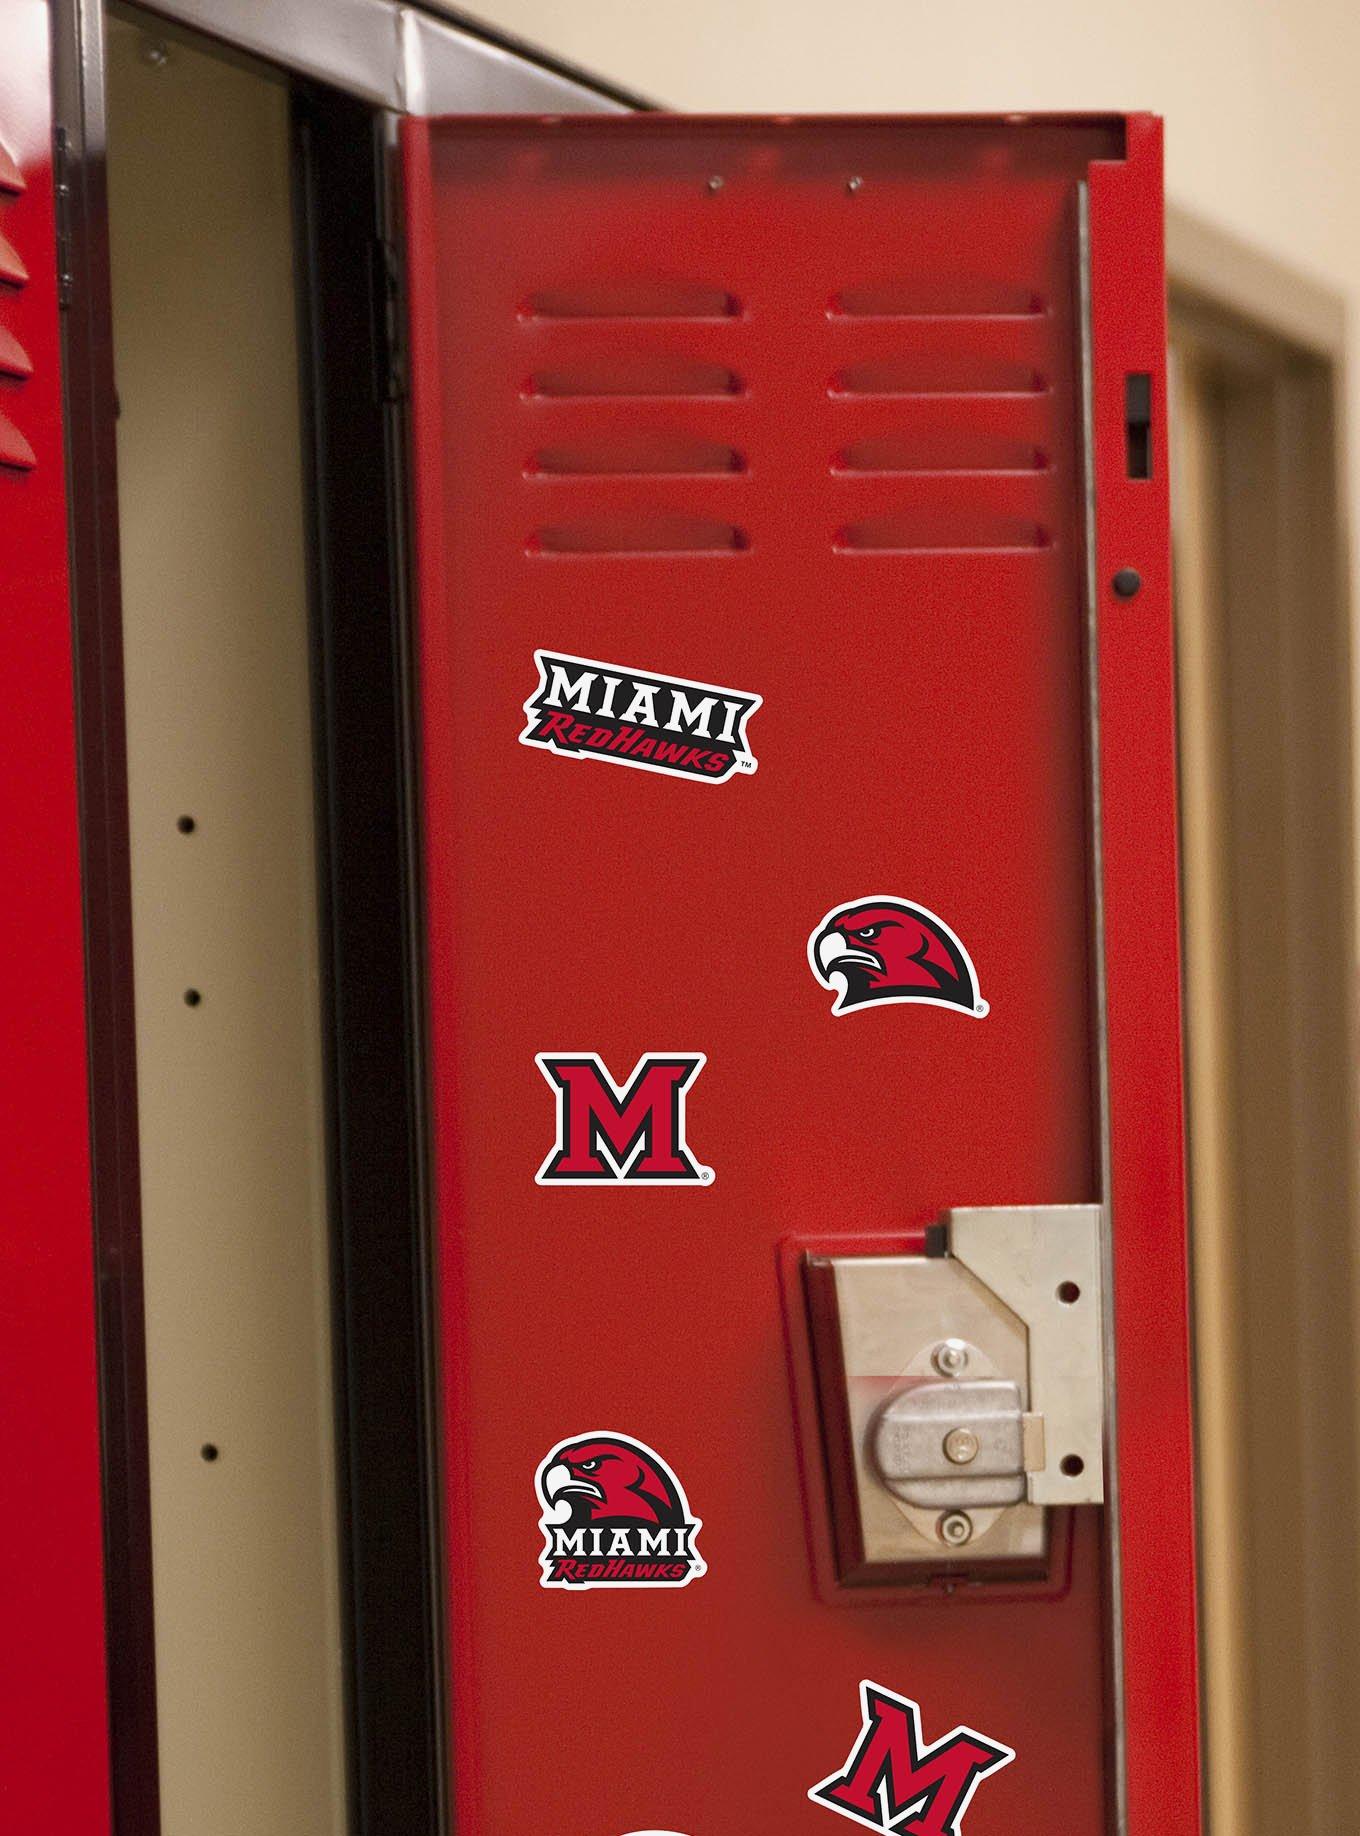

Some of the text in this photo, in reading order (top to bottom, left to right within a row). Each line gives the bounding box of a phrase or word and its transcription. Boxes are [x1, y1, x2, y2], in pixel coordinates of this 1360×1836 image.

[542, 664, 743, 744] MIAMI
[541, 1058, 700, 1179] M
[553, 1528, 688, 1556] MIAMI
[814, 1686, 1009, 1836] M
